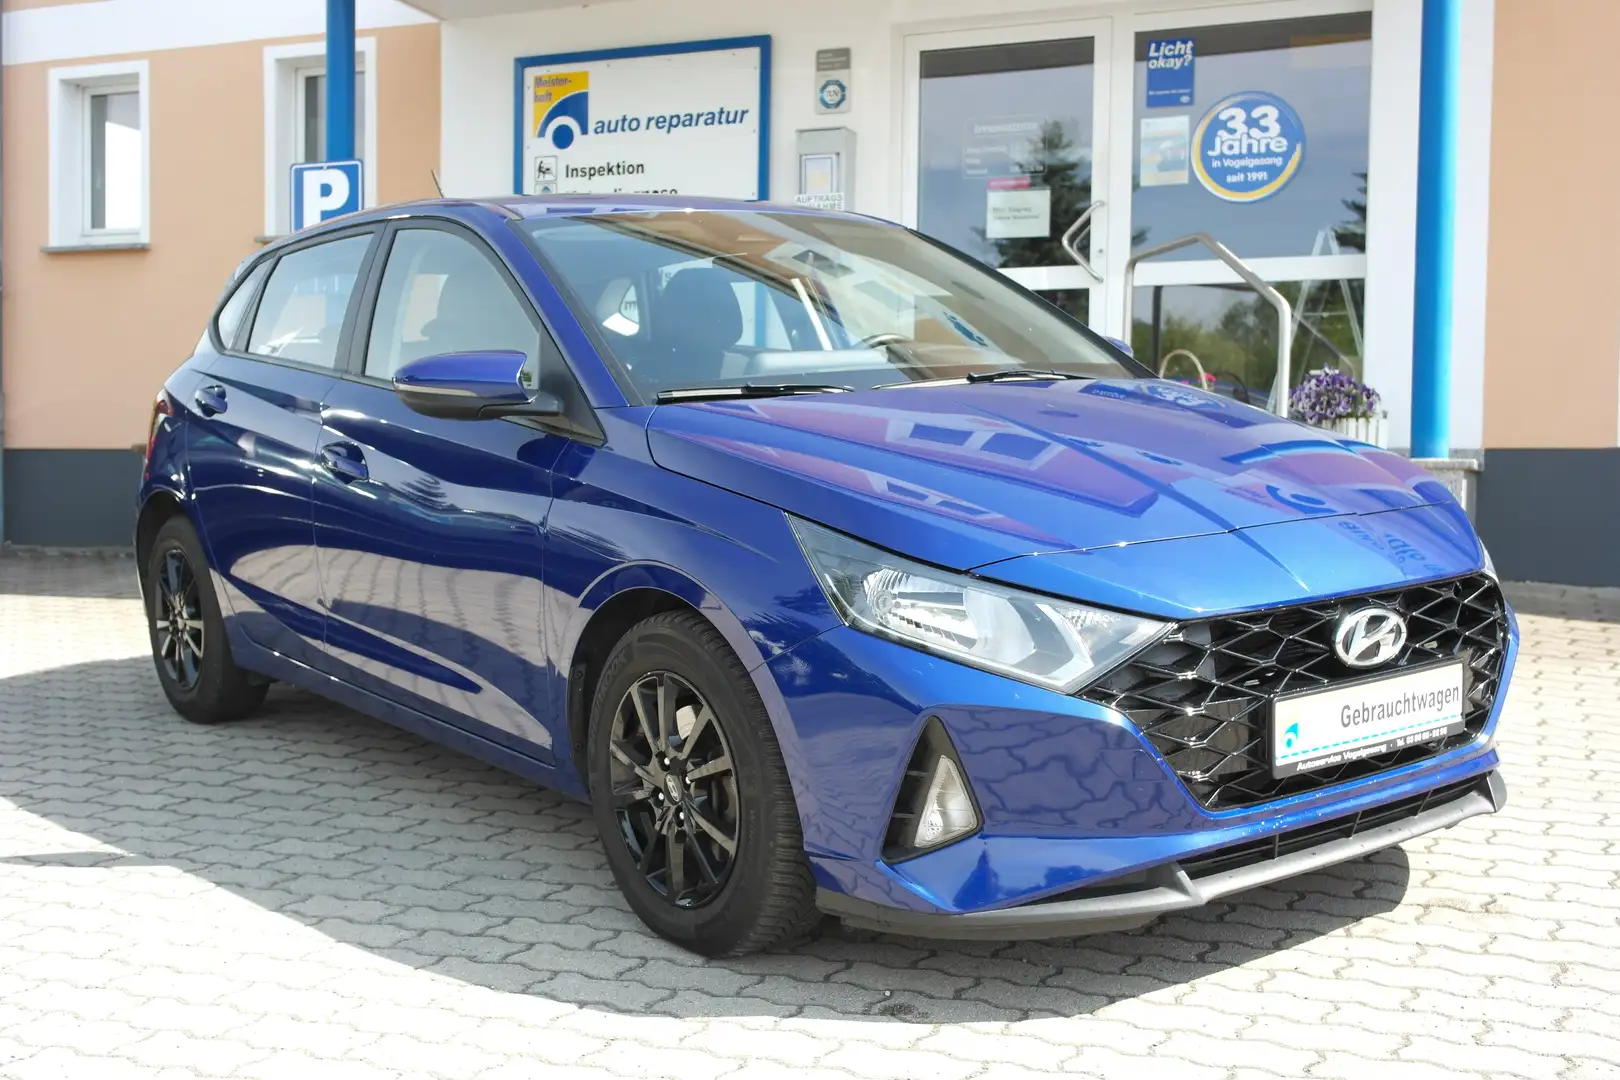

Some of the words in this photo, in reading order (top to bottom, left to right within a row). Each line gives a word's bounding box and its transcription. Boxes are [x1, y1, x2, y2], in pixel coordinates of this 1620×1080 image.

[1149, 41, 1193, 57] Licht
[1149, 54, 1192, 70] okay?
[593, 115, 640, 135] auto
[646, 107, 749, 134] reparatur
[1217, 105, 1281, 139] 33
[1207, 131, 1288, 156] Jahre
[565, 161, 645, 180] Inspektion
[1212, 159, 1221, 168] in
[1226, 172, 1244, 184] seit
[1247, 171, 1268, 182] 1991
[303, 168, 350, 228] P
[1341, 685, 1460, 728] Gebrauchtwagen
